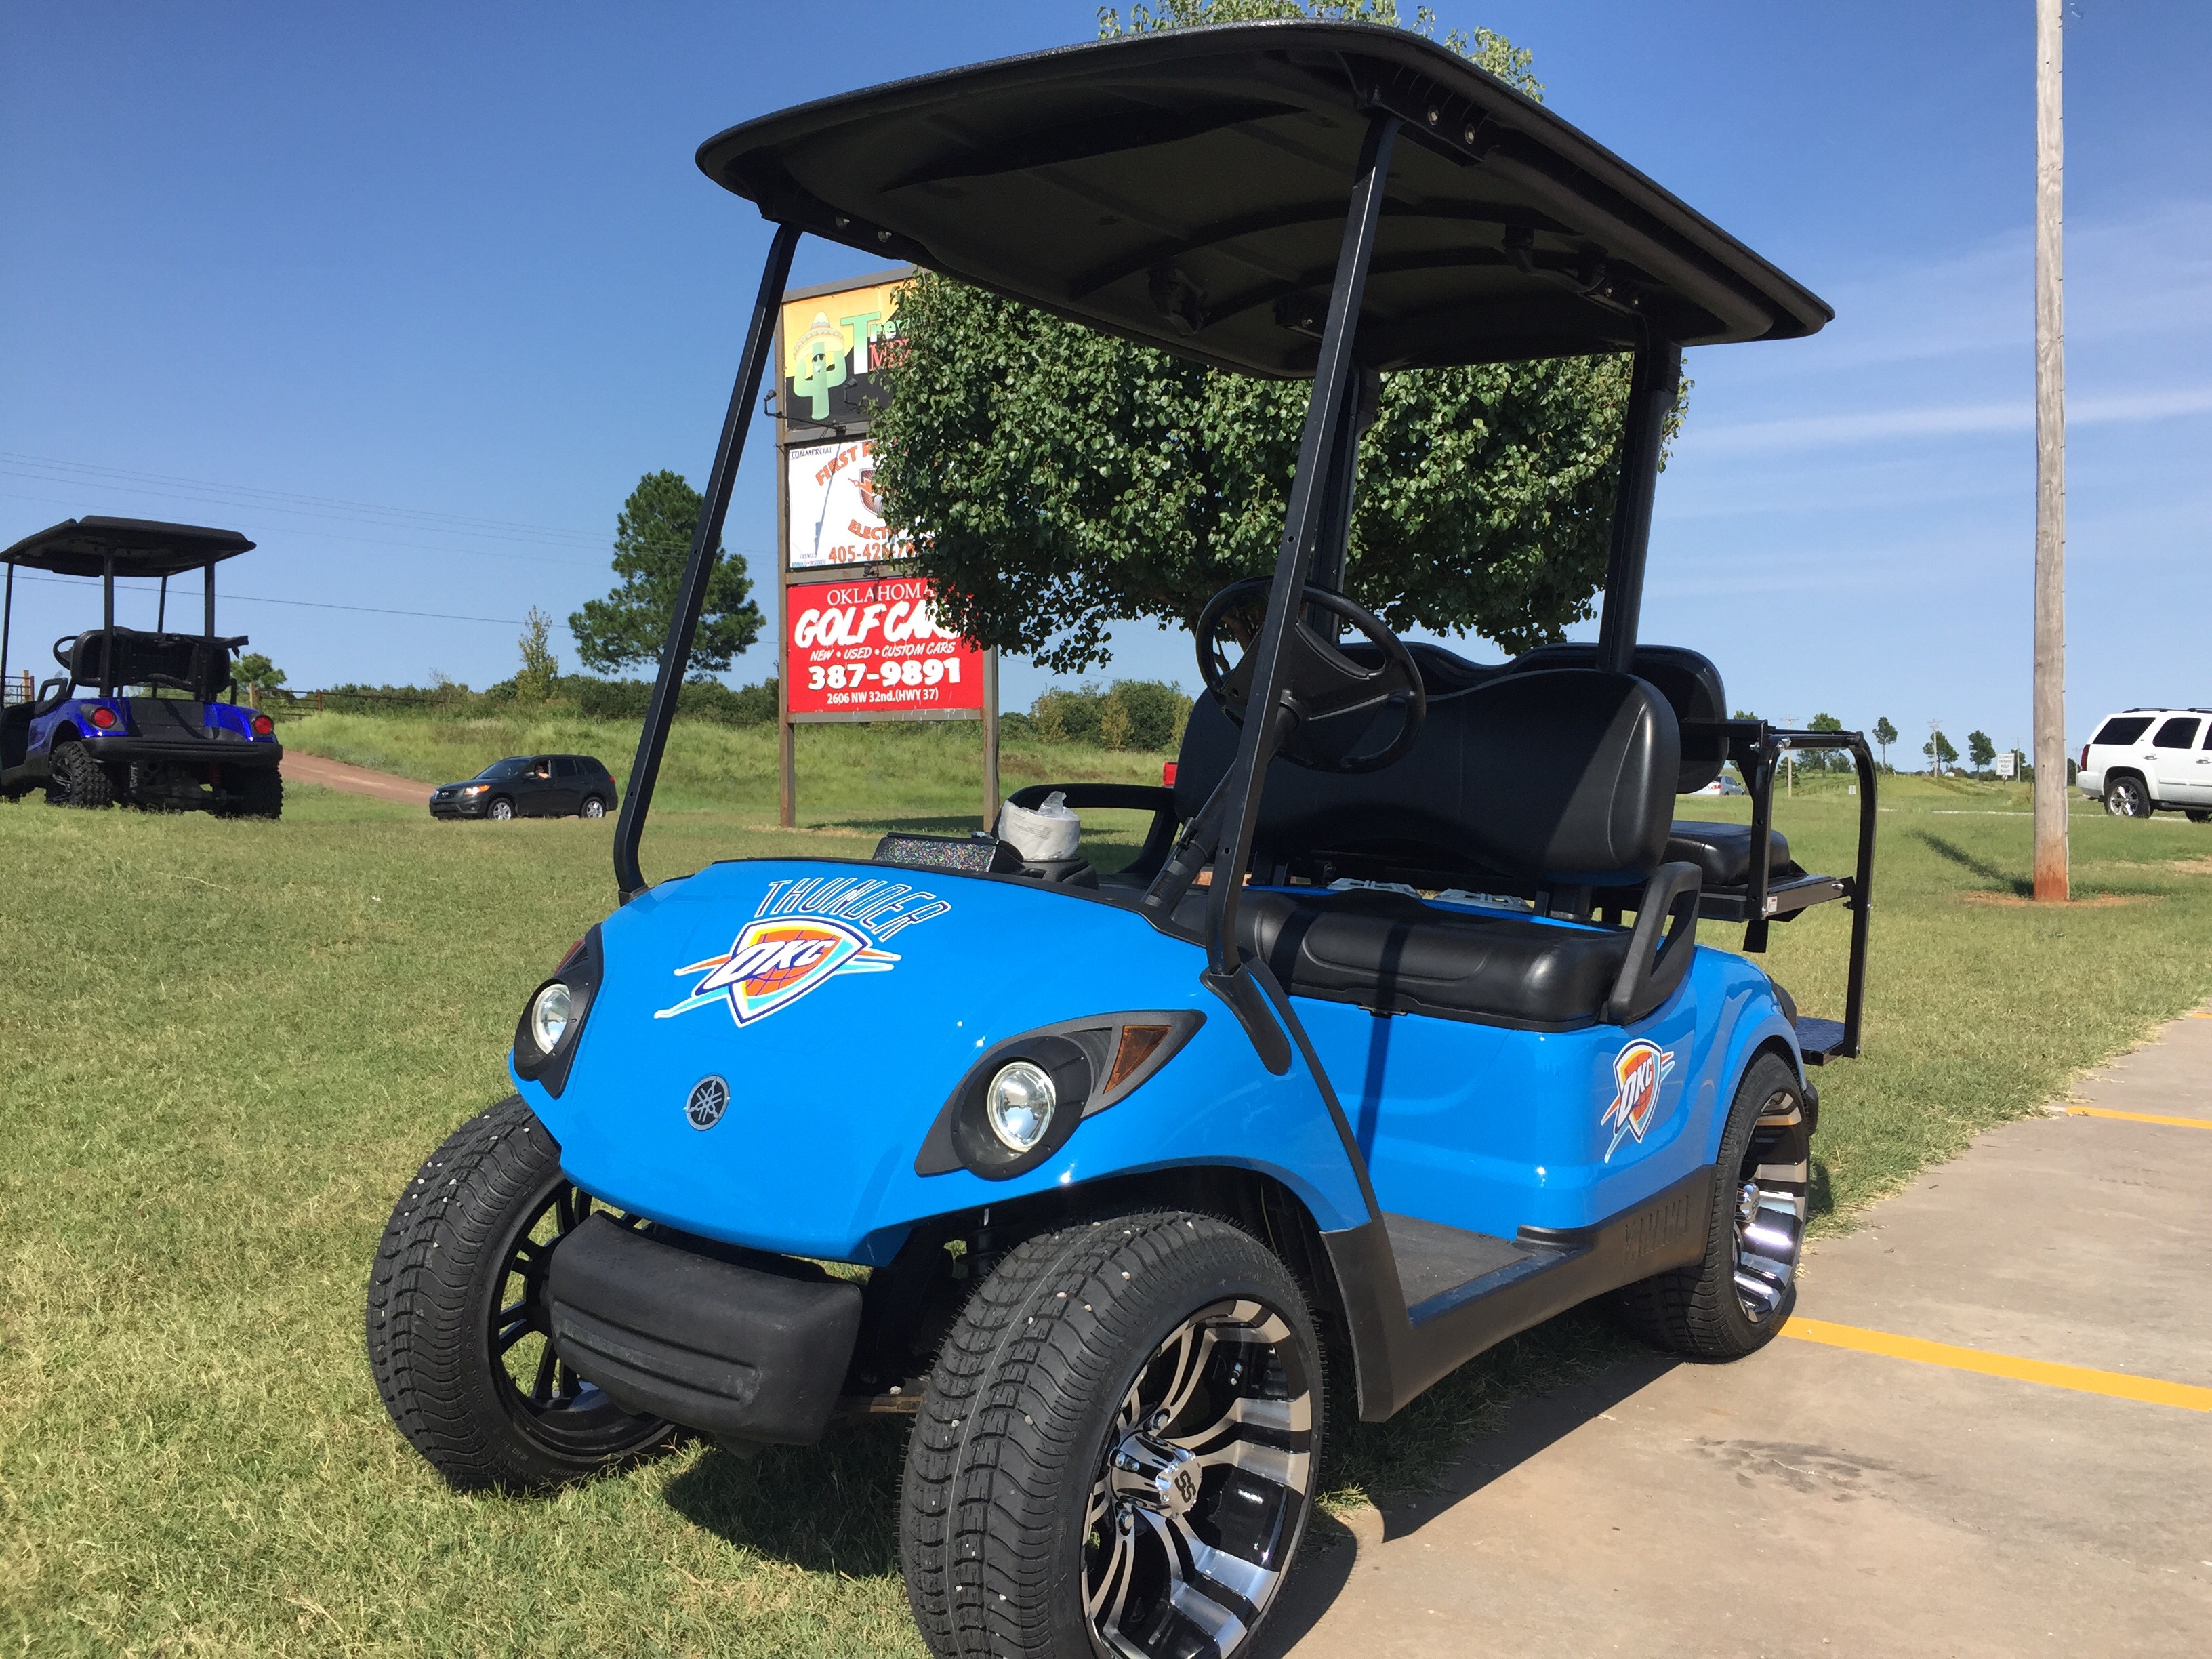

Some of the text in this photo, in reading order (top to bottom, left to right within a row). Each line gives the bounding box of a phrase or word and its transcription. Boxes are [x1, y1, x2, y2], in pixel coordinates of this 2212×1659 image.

[792, 447, 832, 459] COMMERCIAL
[815, 445, 858, 486] FIRST
[794, 603, 887, 648] GOLF
[810, 642, 956, 661] NEW USED CUSTOM CARS
[808, 657, 960, 690] 387-9891
[827, 693, 850, 704] 2606
[851, 692, 867, 703] NW
[923, 687, 939, 701] 37)
[754, 877, 952, 943] THUNDER
[702, 939, 838, 990] OKC
[1616, 1057, 1653, 1128] OKC
